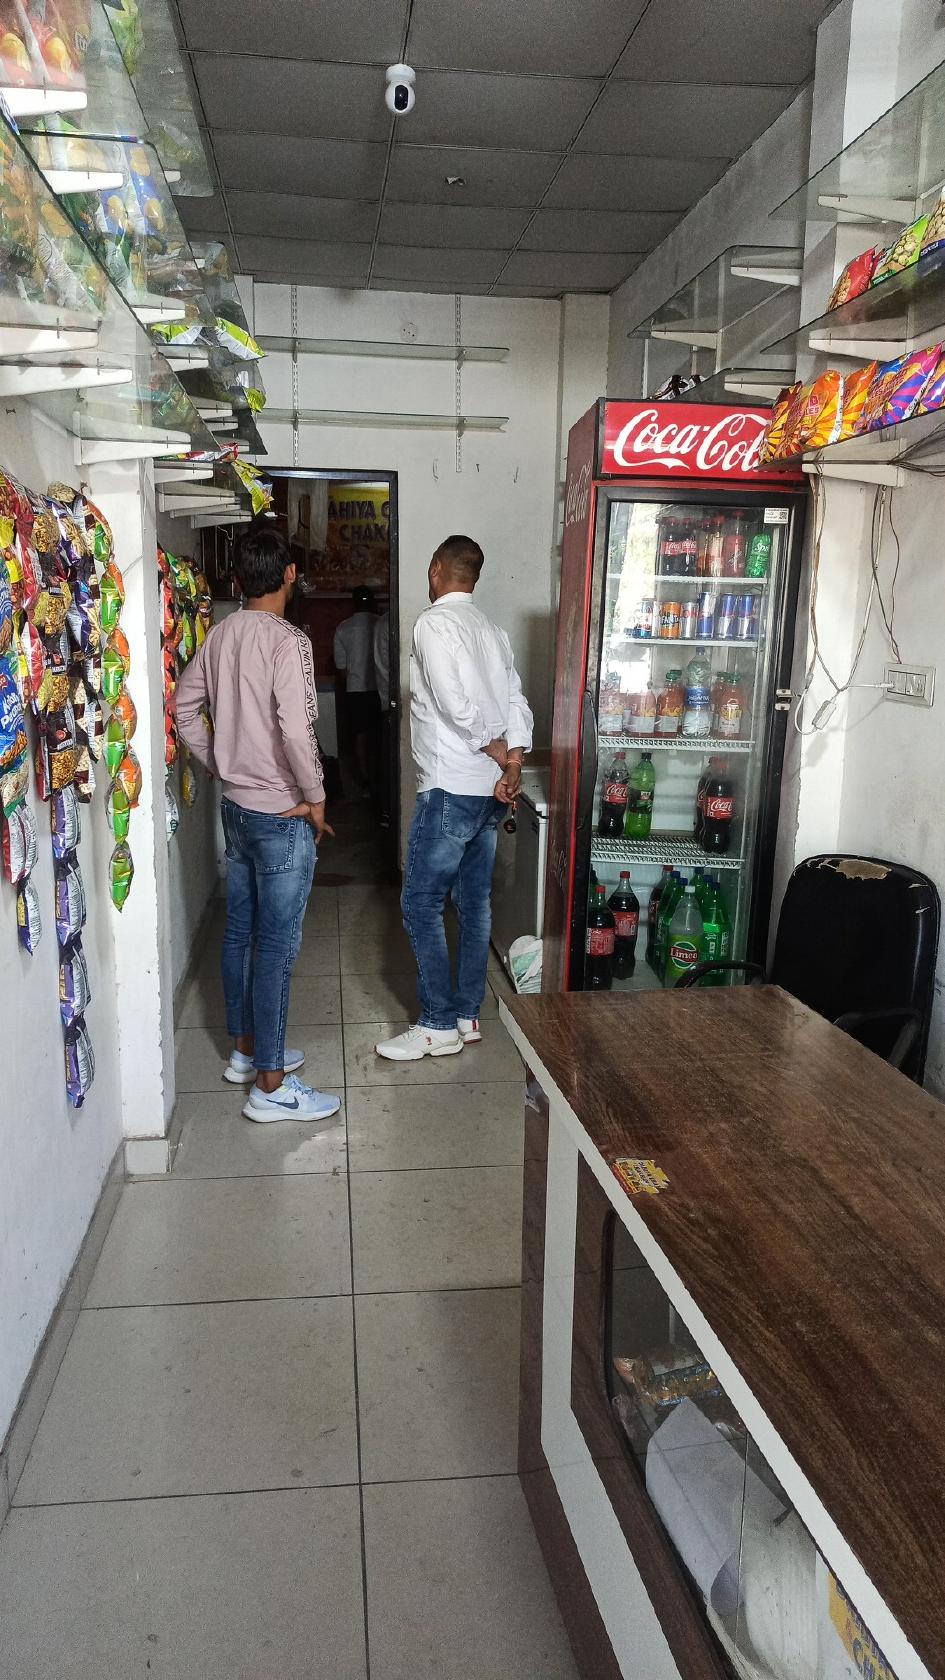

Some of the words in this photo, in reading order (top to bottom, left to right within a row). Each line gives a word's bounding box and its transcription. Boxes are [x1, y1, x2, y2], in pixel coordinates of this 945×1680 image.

[613, 408, 771, 473] Coca-Col
[328, 501, 377, 520] AHIYA
[339, 524, 388, 543] CHAK
